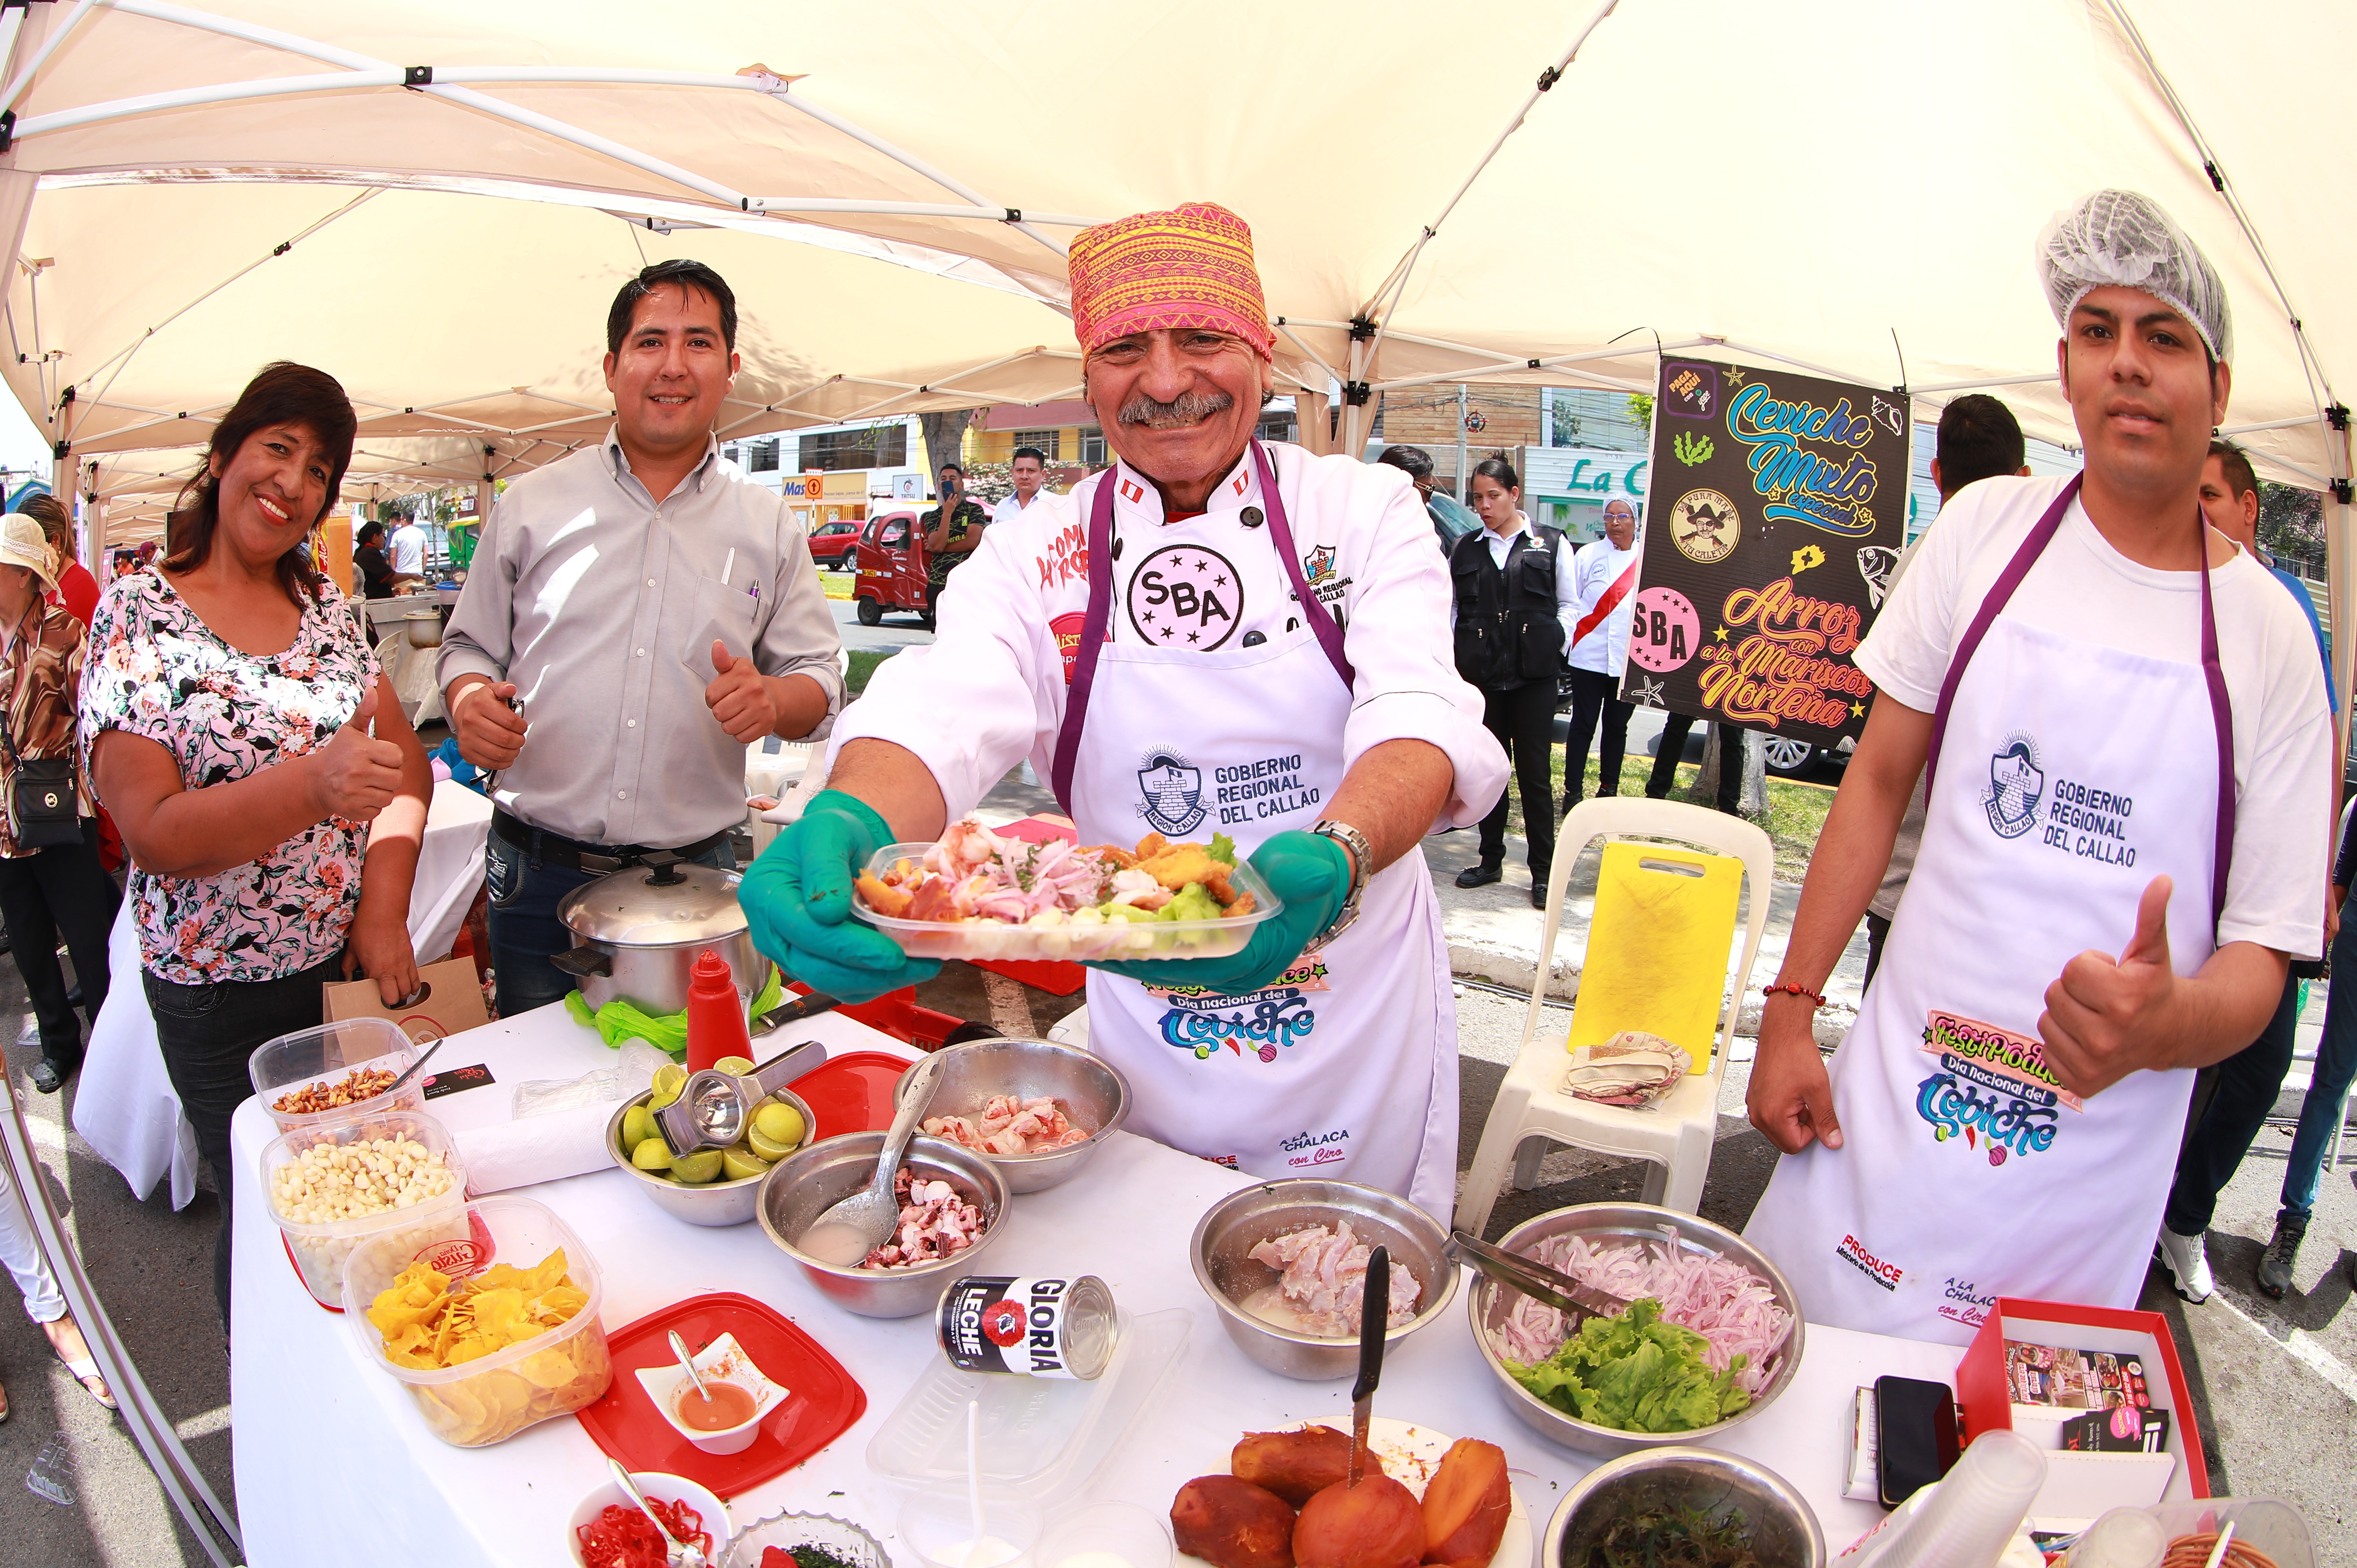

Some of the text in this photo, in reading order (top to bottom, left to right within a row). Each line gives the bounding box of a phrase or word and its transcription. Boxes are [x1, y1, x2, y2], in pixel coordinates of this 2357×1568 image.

[1669, 370, 1692, 393] PAGA
[1680, 373, 1701, 396] AQUÍ
[1684, 390, 1711, 411] con yape
[1727, 383, 1873, 449] Ceviche
[1566, 459, 1611, 493] La
[1748, 441, 1876, 503] Mixto
[1787, 491, 1856, 524] especial
[1141, 571, 1231, 627] SBA
[1320, 589, 1345, 603] CALLAO
[1322, 577, 1353, 593] REGIONAL
[1633, 602, 1688, 660] SBA
[1724, 577, 1860, 655] Arroz
[1701, 645, 1734, 662] a la
[1790, 639, 1816, 654] con
[1737, 636, 1872, 697] Mariscos
[1700, 663, 1847, 727] Norteña
[1215, 755, 1301, 783] GOBIERNO
[1217, 775, 1304, 804] REGIONAL
[1220, 788, 1320, 824] DEL CALLAO
[2055, 779, 2132, 817] GOBIERNO
[1148, 810, 1201, 833] REGION CALLAO
[1988, 803, 2030, 834] REGION CALLAO
[2050, 801, 2125, 841] REGIONAL
[2044, 825, 2136, 868] DEL CALLAO
[1176, 990, 1287, 1009] Día nacional del
[1948, 1056, 2047, 1104] Día nacional del
[1916, 1073, 2058, 1156] Cebiche
[1284, 1130, 1349, 1151] CHALACA
[1291, 1131, 1308, 1141] LA
[1288, 1147, 1343, 1166] con Ciro
[1836, 1246, 1896, 1292] Ministerio de la Producción
[1842, 1233, 1903, 1283] PRODUCE
[1944, 1278, 1974, 1292] A LA
[1944, 1288, 1998, 1307] CHALAC
[955, 1288, 968, 1322] RECONSTITUIDA
[960, 1288, 988, 1355] LECHE
[1937, 1305, 1958, 1316] con
[1029, 1279, 1068, 1372] GLORIA
